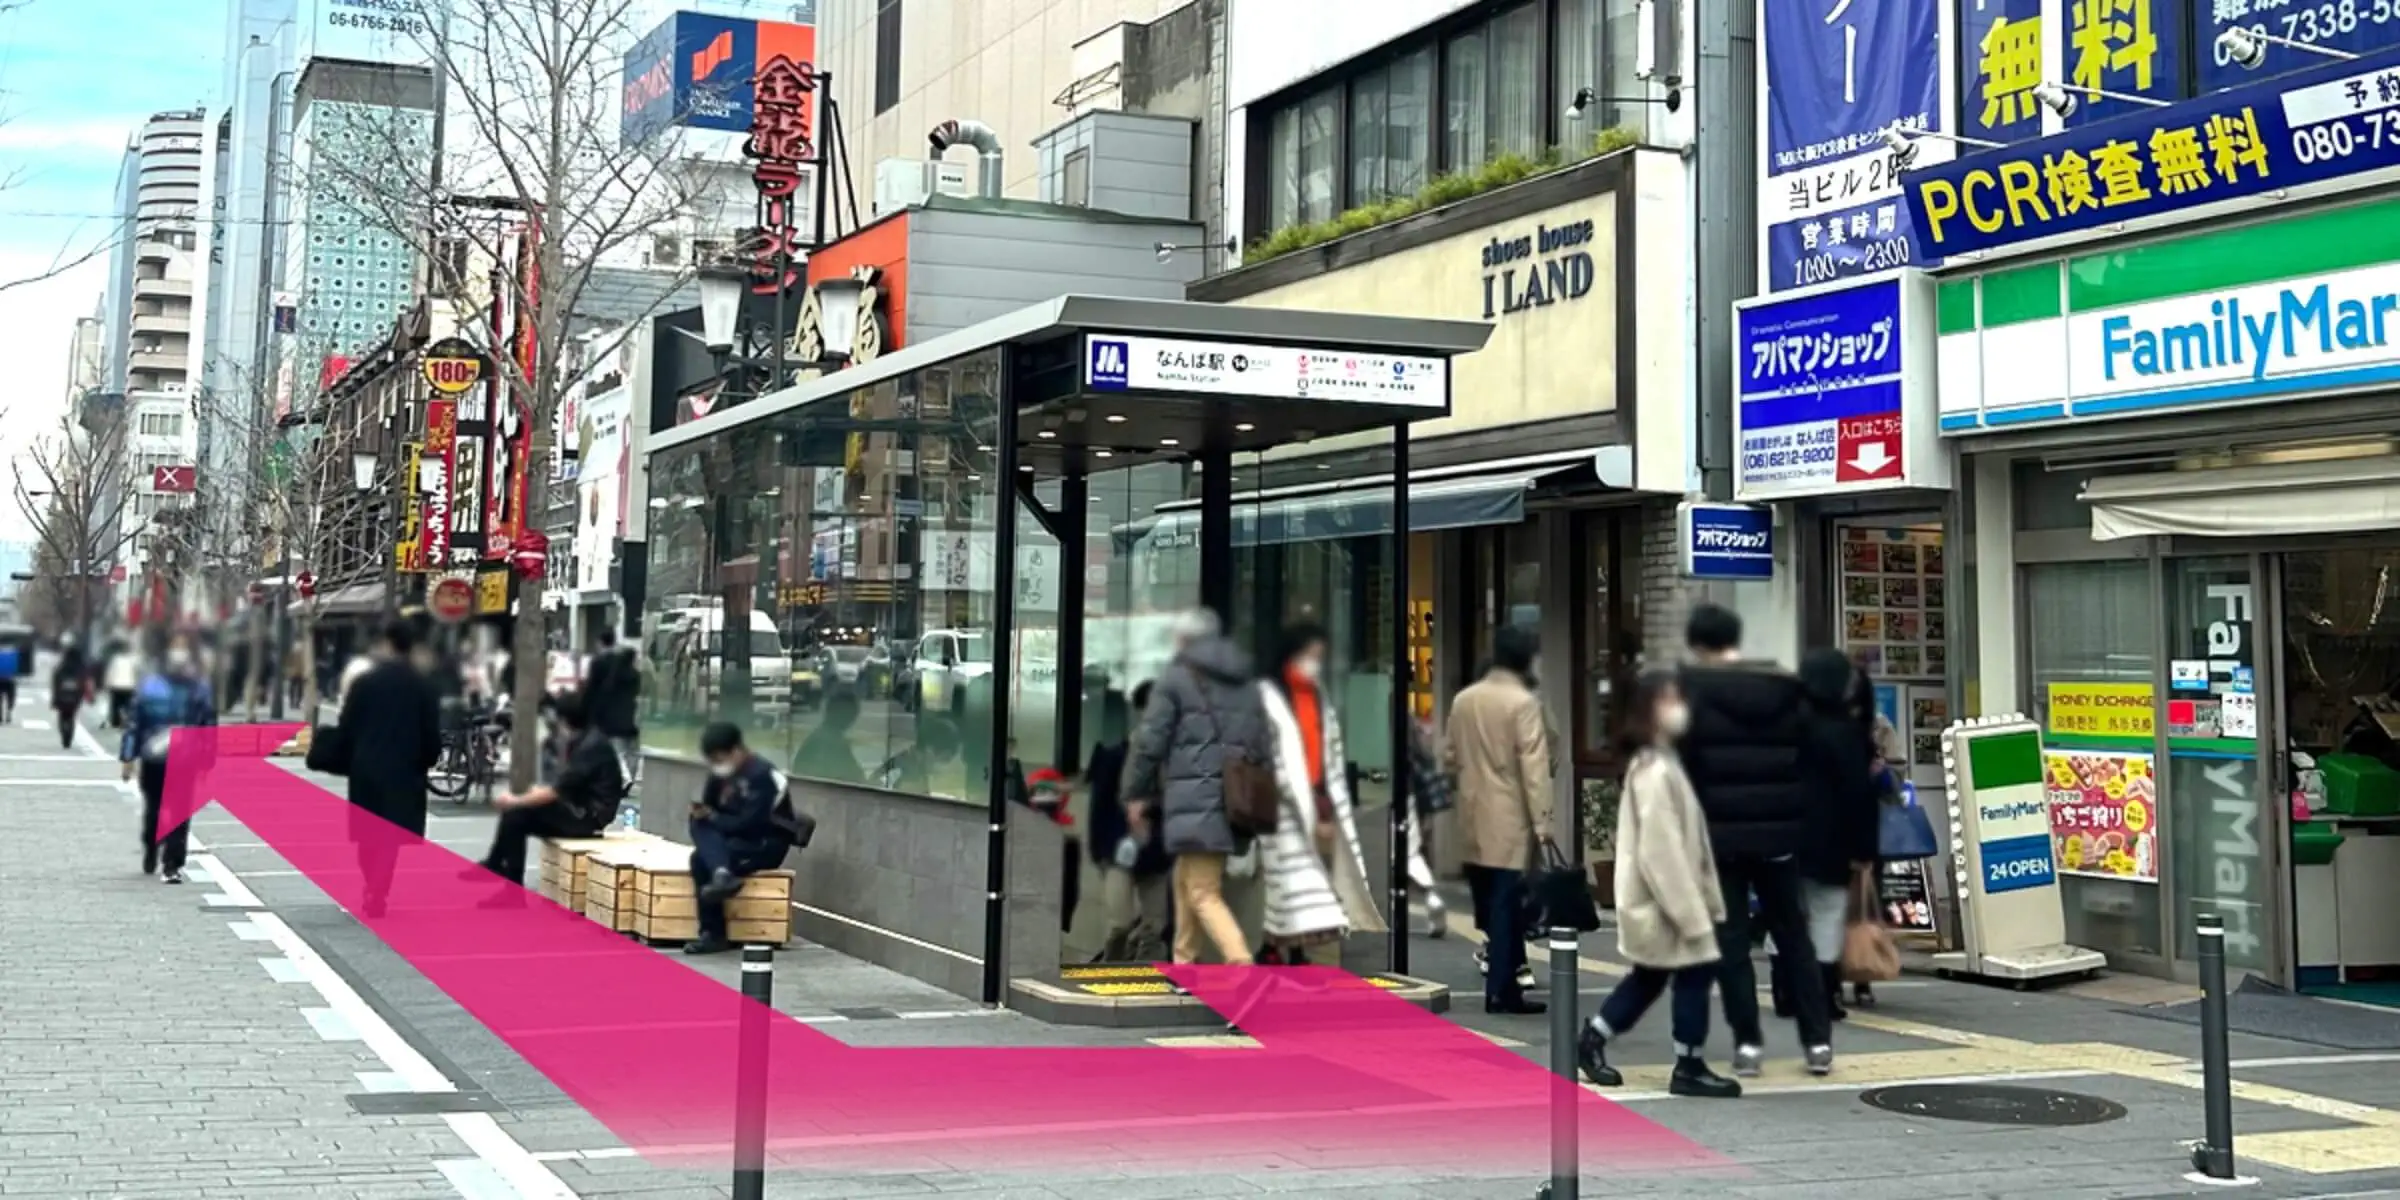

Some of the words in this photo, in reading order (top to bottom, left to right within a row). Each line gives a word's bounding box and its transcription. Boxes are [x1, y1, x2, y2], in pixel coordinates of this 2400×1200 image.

[1920, 107, 2271, 244] PCR検査無料
[1481, 234, 1531, 267] shoes
[1537, 217, 1594, 254] house
[1801, 204, 1897, 251] 営業時間
[1501, 251, 1594, 316] LAND
[1750, 315, 1893, 380] アパマンショップ
[2102, 284, 2400, 382] FamilyMar
[1156, 349, 1226, 372] なんば駅
[1840, 415, 1904, 440] 入口はこちら
[1979, 801, 2046, 821] FamilyMart
